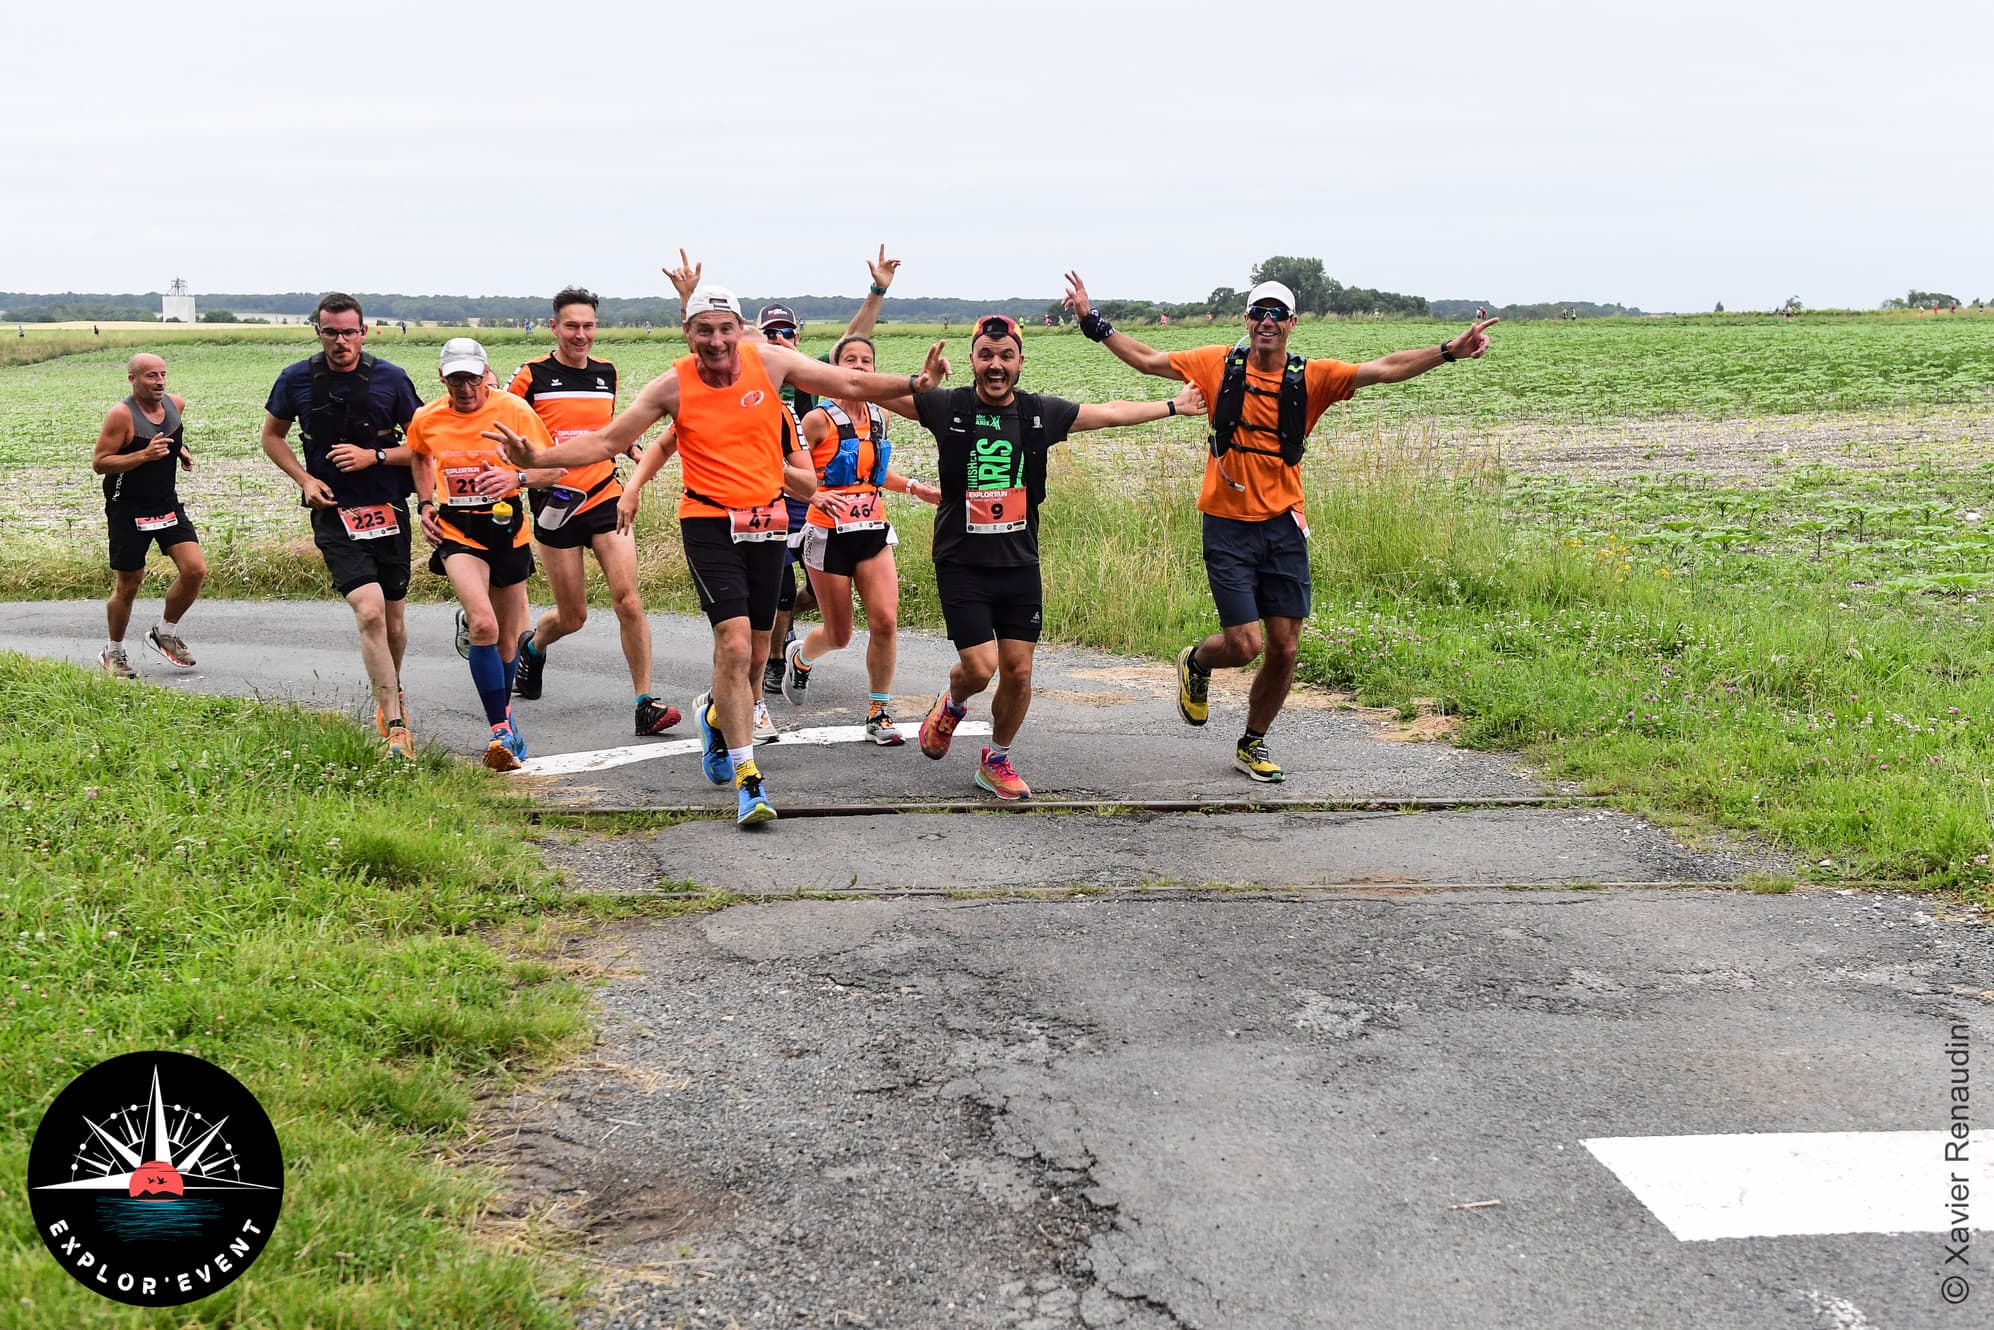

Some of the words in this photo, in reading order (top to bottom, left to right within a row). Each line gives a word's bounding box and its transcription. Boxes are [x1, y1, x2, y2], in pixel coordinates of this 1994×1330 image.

[966, 450, 978, 491] INISHER
[976, 438, 1013, 491] ARIS
[456, 478, 476, 494] 21
[850, 504, 870, 518] 46
[991, 503, 1004, 520] 9
[352, 511, 386, 529] 225
[749, 514, 771, 529] 47
